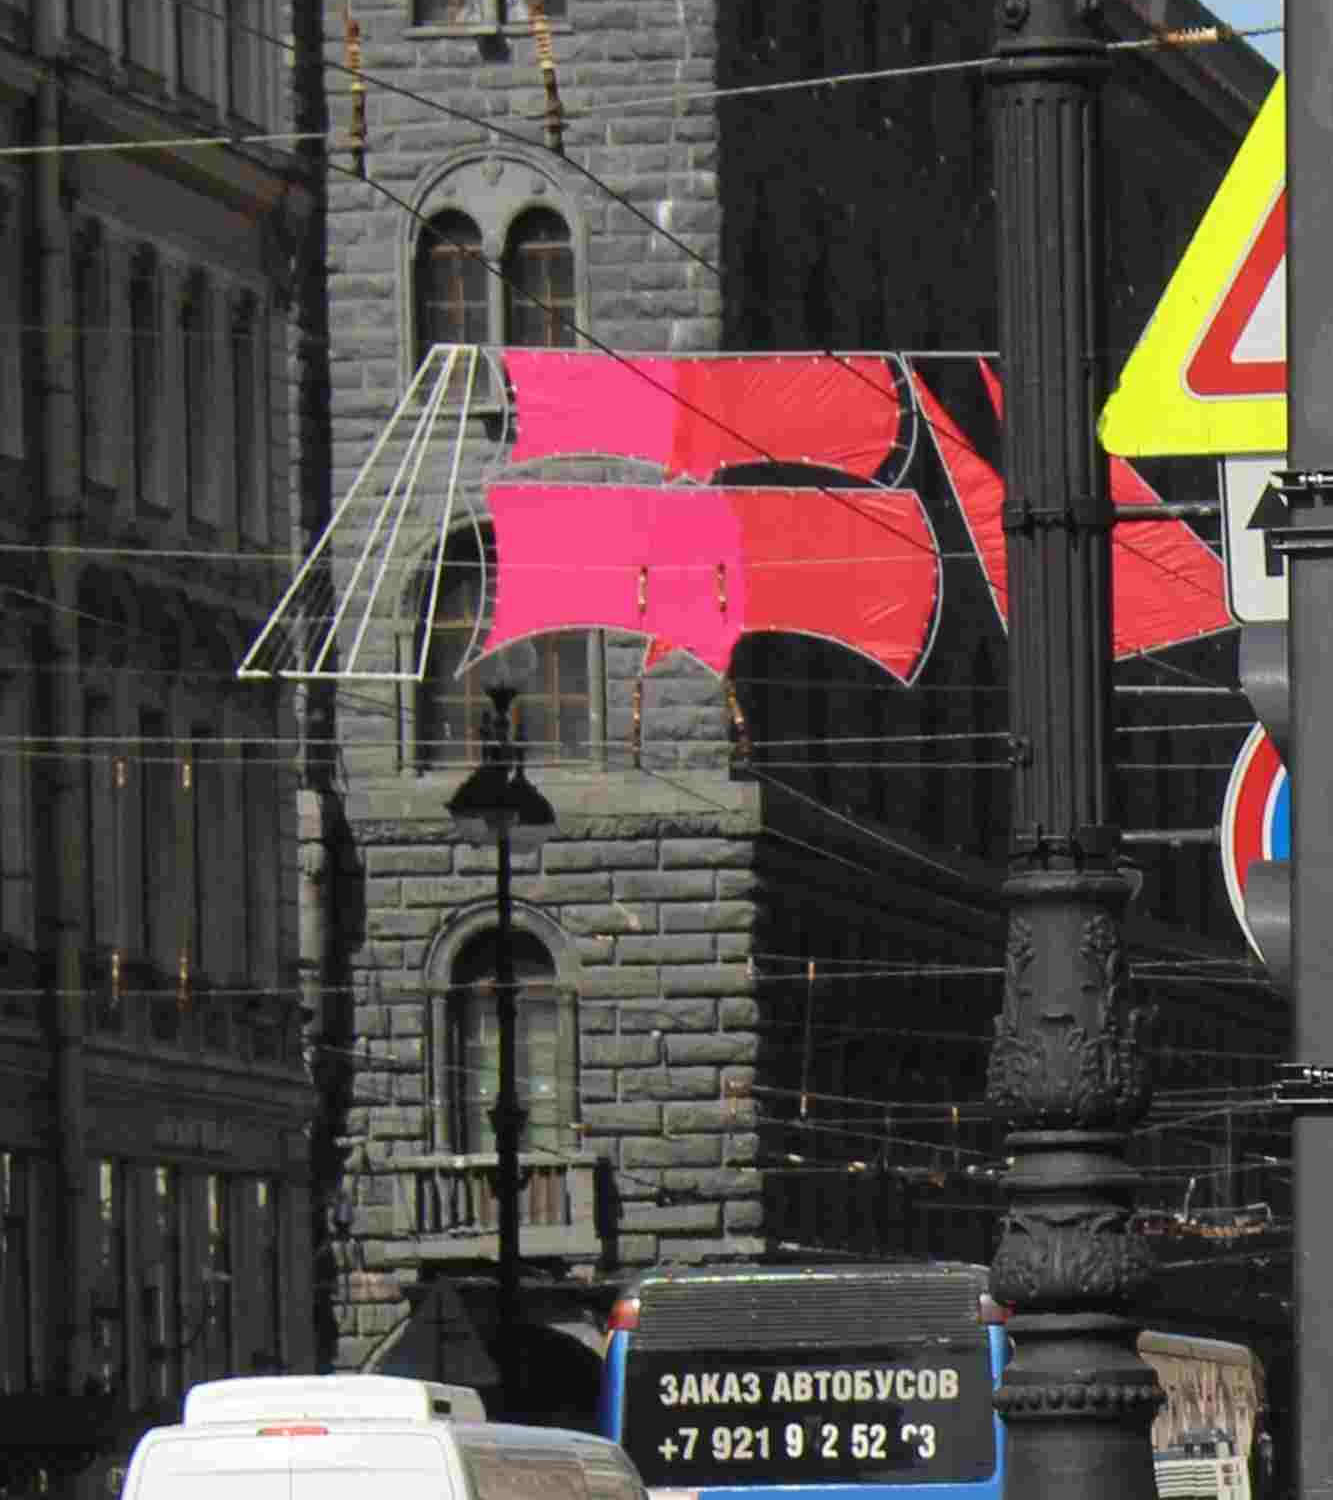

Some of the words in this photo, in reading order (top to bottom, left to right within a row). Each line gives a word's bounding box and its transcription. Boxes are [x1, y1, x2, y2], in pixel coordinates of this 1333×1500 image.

[659, 1372, 762, 1405] ЗАКАЗ
[771, 1369, 959, 1403] АВТОБУСОВ
[658, 1426, 699, 1460] +7
[712, 1426, 770, 1460] 921
[851, 1423, 887, 1460] 52
